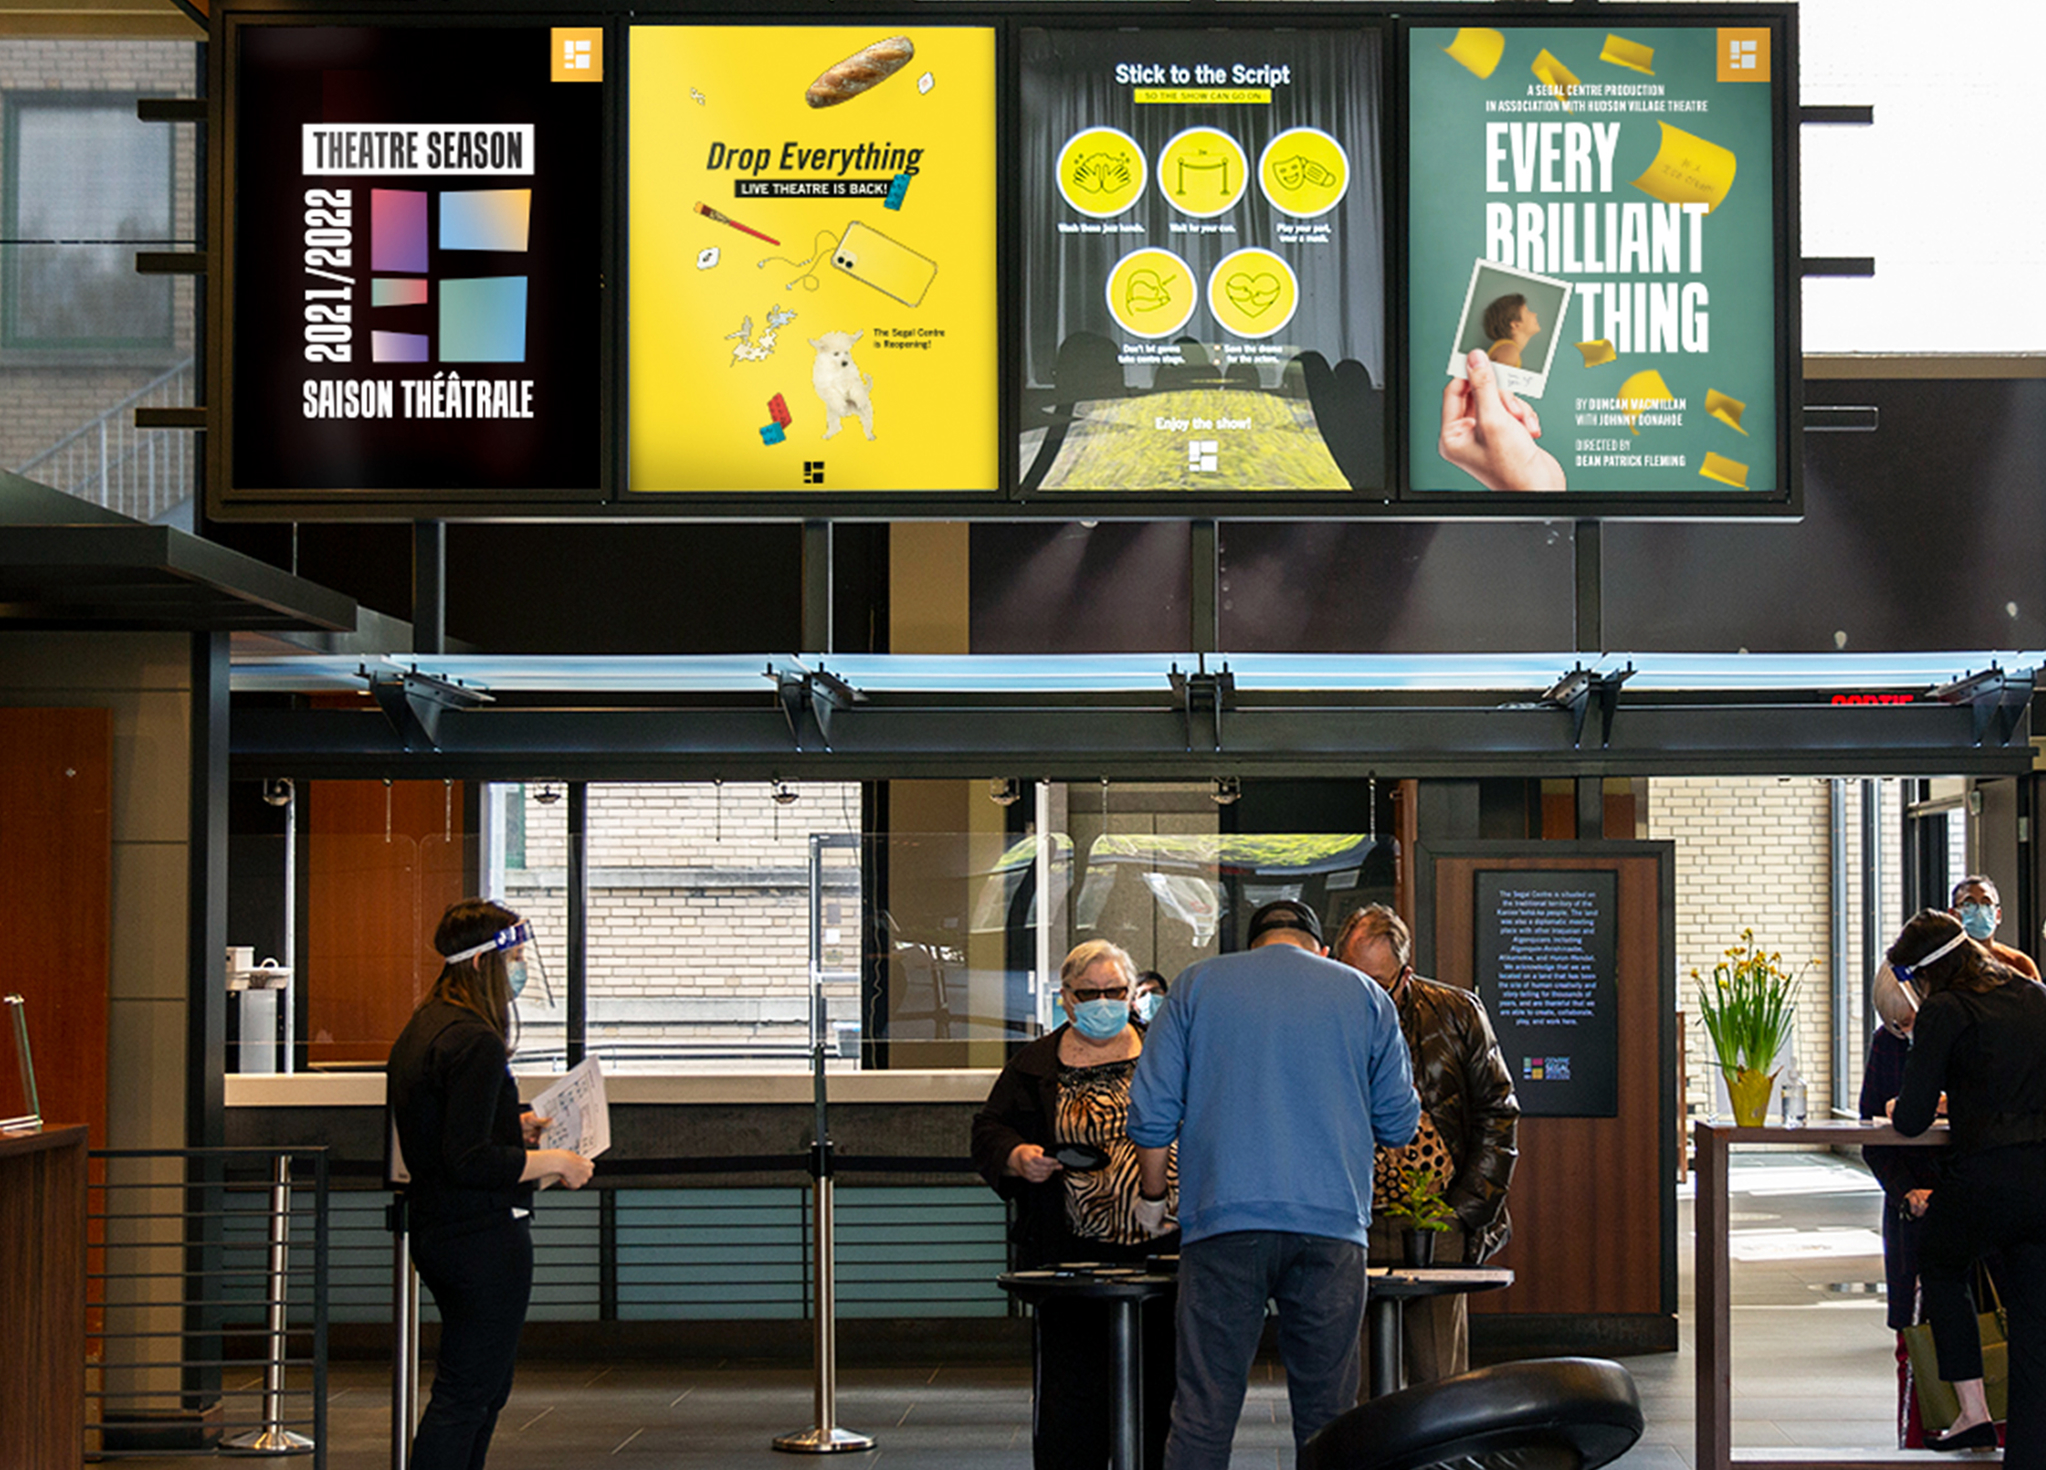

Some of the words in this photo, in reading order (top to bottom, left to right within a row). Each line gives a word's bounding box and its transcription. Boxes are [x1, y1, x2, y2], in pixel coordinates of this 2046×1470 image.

[1115, 63, 1166, 85] Stick
[1169, 63, 1191, 85] to
[1194, 63, 1227, 85] the
[1232, 63, 1291, 88] Script
[1145, 92, 1157, 100] SO
[1160, 92, 1177, 100] THE
[1181, 92, 1208, 100] SHOW
[1210, 92, 1229, 100] CAN
[1232, 92, 1246, 100] GO
[1247, 92, 1261, 100] ON
[1527, 84, 1534, 96] A
[1536, 84, 1565, 96] SEGAL
[1566, 84, 1603, 96] CENTRE
[1604, 84, 1665, 96] PRODUCTION
[1485, 100, 1497, 112] IN
[1498, 100, 1560, 112] ASSOCIATION
[1561, 100, 1586, 112] WITH
[1587, 100, 1626, 112] HUDSON
[1627, 100, 1666, 112] VILLAGE
[1667, 100, 1709, 112] THEATRE
[313, 131, 418, 169] THEATRE
[427, 131, 522, 169] SEASON
[706, 142, 771, 176] Drop
[779, 142, 924, 176] Everything
[1485, 122, 1621, 193] EVERY
[741, 183, 769, 194] LIVE
[772, 183, 829, 194] THEATRE
[833, 183, 846, 194] IS
[850, 183, 888, 194] BACK!
[1485, 202, 1710, 273] BRILLIANT
[304, 188, 355, 363] 2021/2022
[1575, 283, 1710, 353] THING
[873, 328, 889, 337] The
[892, 328, 916, 339] Segal
[917, 328, 945, 337] Centre
[874, 340, 881, 348] is
[884, 340, 931, 351] Reopening!
[303, 380, 393, 418] SAISON
[401, 370, 534, 418] THÉÂTRALE
[1575, 398, 1587, 410] BY
[1588, 398, 1628, 410] DUNCAN
[1630, 398, 1686, 410] MACMILLAN
[1155, 417, 1190, 432] Enjoy
[1192, 417, 1213, 430] the
[1216, 417, 1252, 430] show!
[1575, 413, 1598, 426] WITH
[1599, 413, 1637, 426] JOHNNY
[1638, 413, 1683, 426] DONAHOE
[1575, 439, 1618, 451] DIRECTED
[1620, 439, 1631, 451] BY
[1575, 454, 1601, 467] DEAN
[1603, 454, 1642, 467] PATRICK
[1644, 454, 1686, 467] FLEMING
